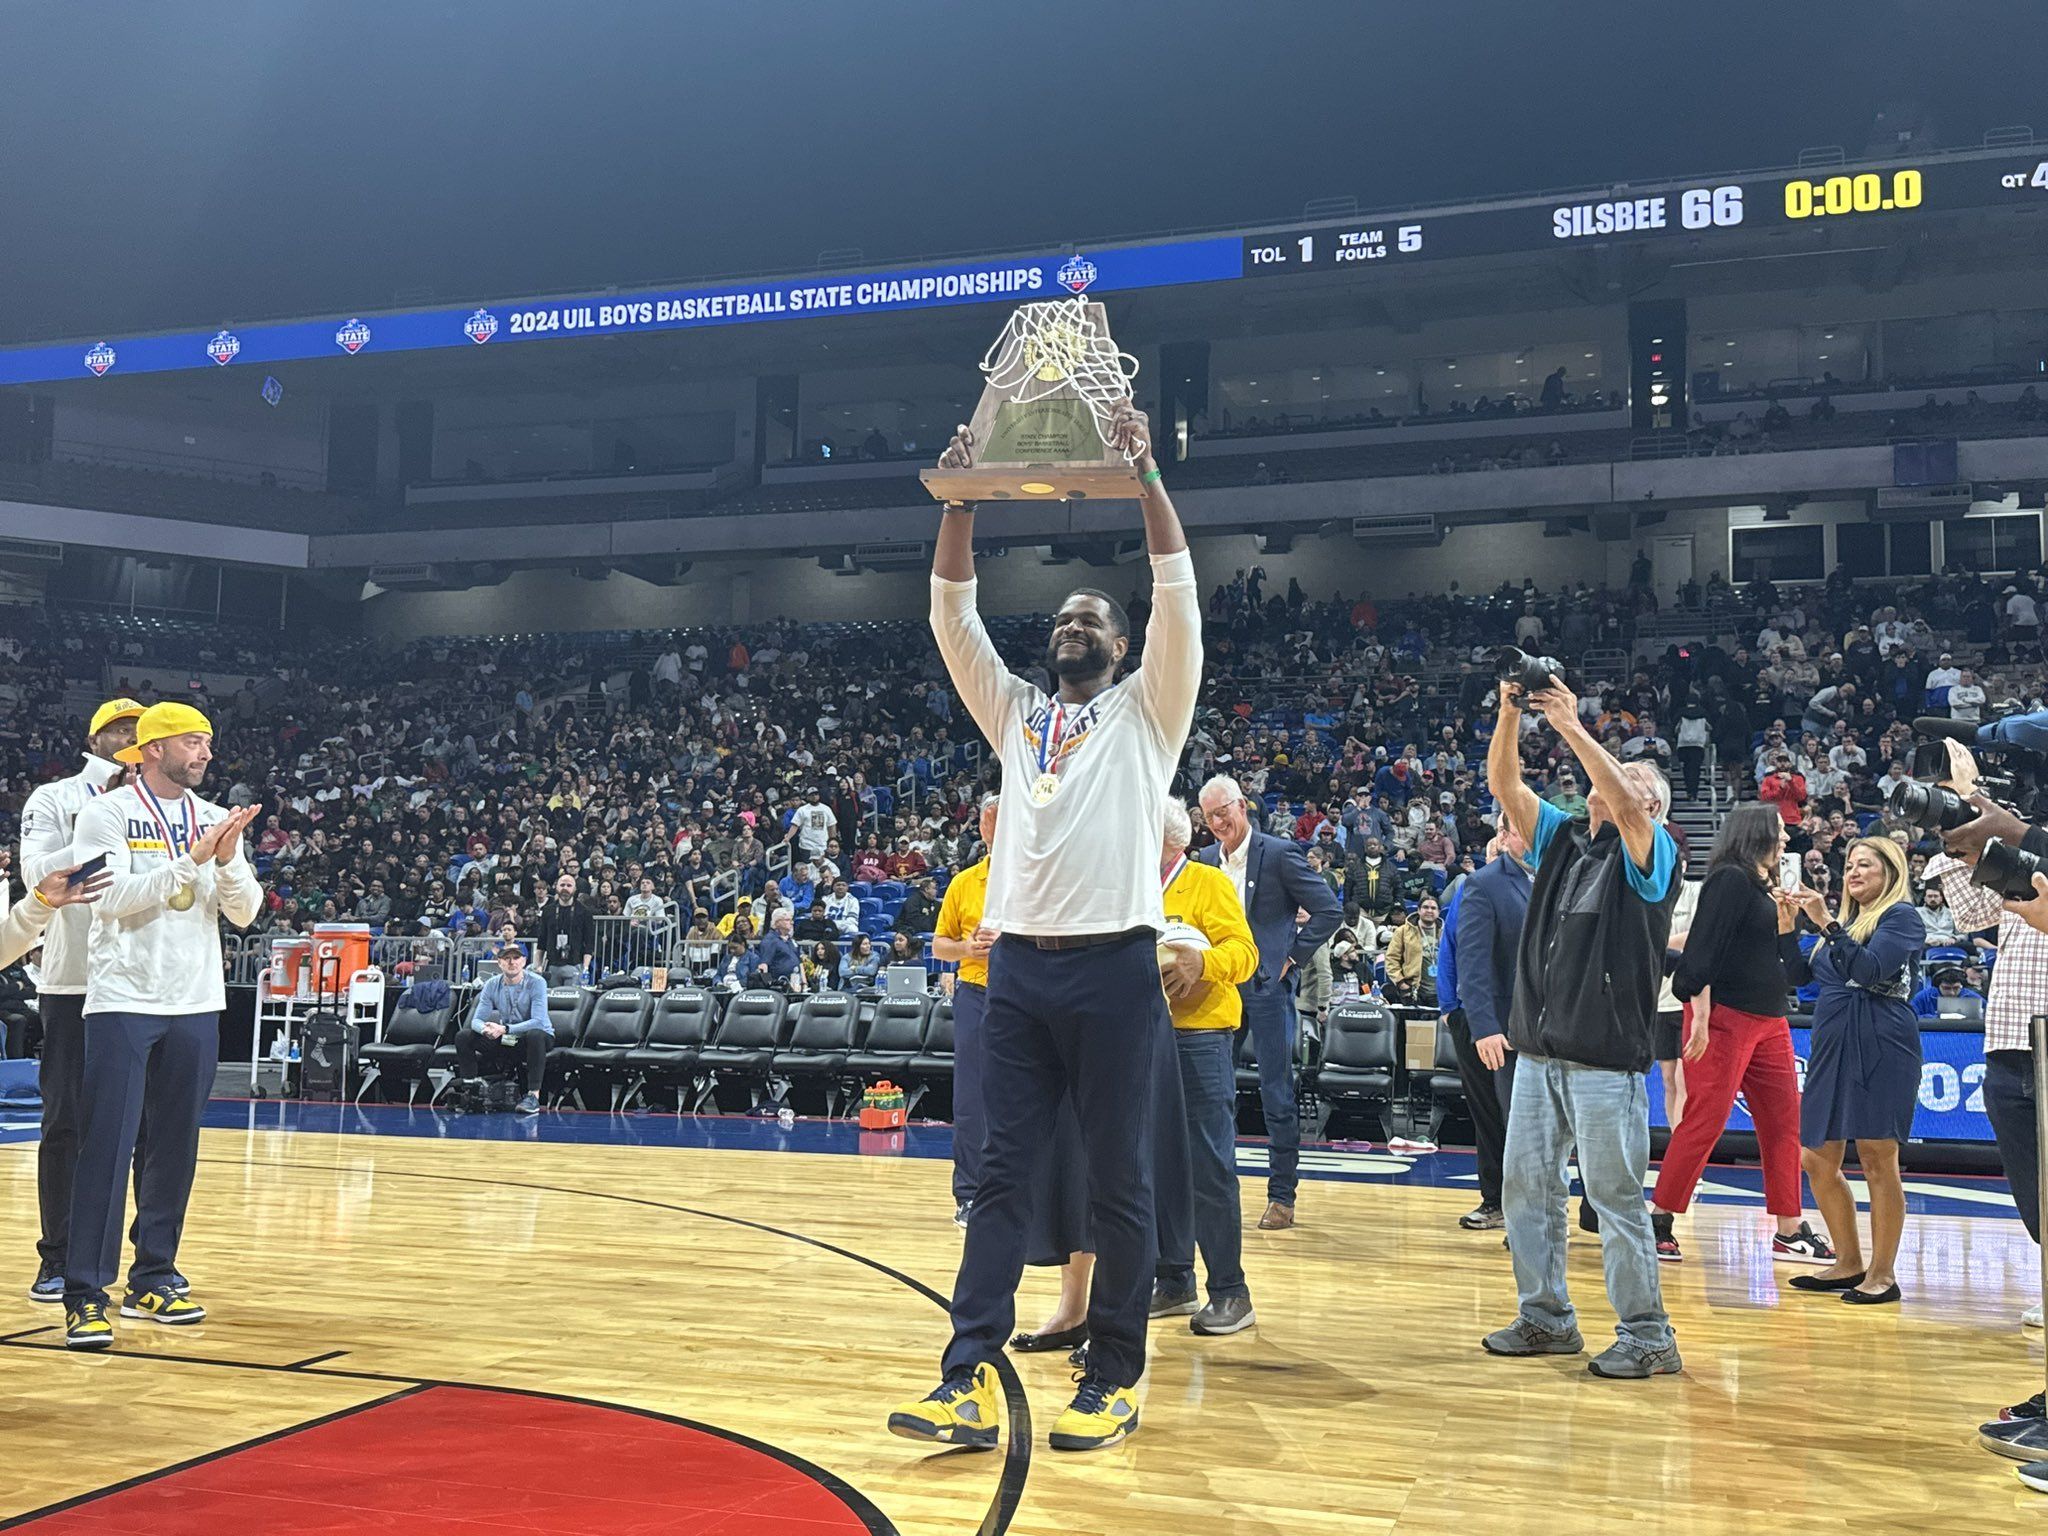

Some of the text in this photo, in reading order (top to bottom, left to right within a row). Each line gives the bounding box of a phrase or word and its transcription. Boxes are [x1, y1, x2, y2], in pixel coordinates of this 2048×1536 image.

[2001, 173, 2027, 188] QT
[1784, 170, 1922, 219] 0:00.0
[1553, 185, 1744, 239] SILSBEE 66
[1339, 230, 1383, 247] TEAM
[1398, 225, 1422, 252] 5
[1251, 236, 1313, 264] TOL 1
[1335, 245, 1387, 262] FOULS
[1059, 270, 1095, 281] STATE
[510, 267, 1043, 334] 2024 UIL BOYS BASKETBALL STATE CHAMPIONSHIPS
[466, 322, 496, 333] STATE
[338, 331, 368, 342] STATE
[209, 343, 238, 354] STATE
[86, 354, 114, 365] STATE
[863, 857, 879, 866] GAP
[318, 942, 333, 959] G
[272, 954, 284, 969] G
